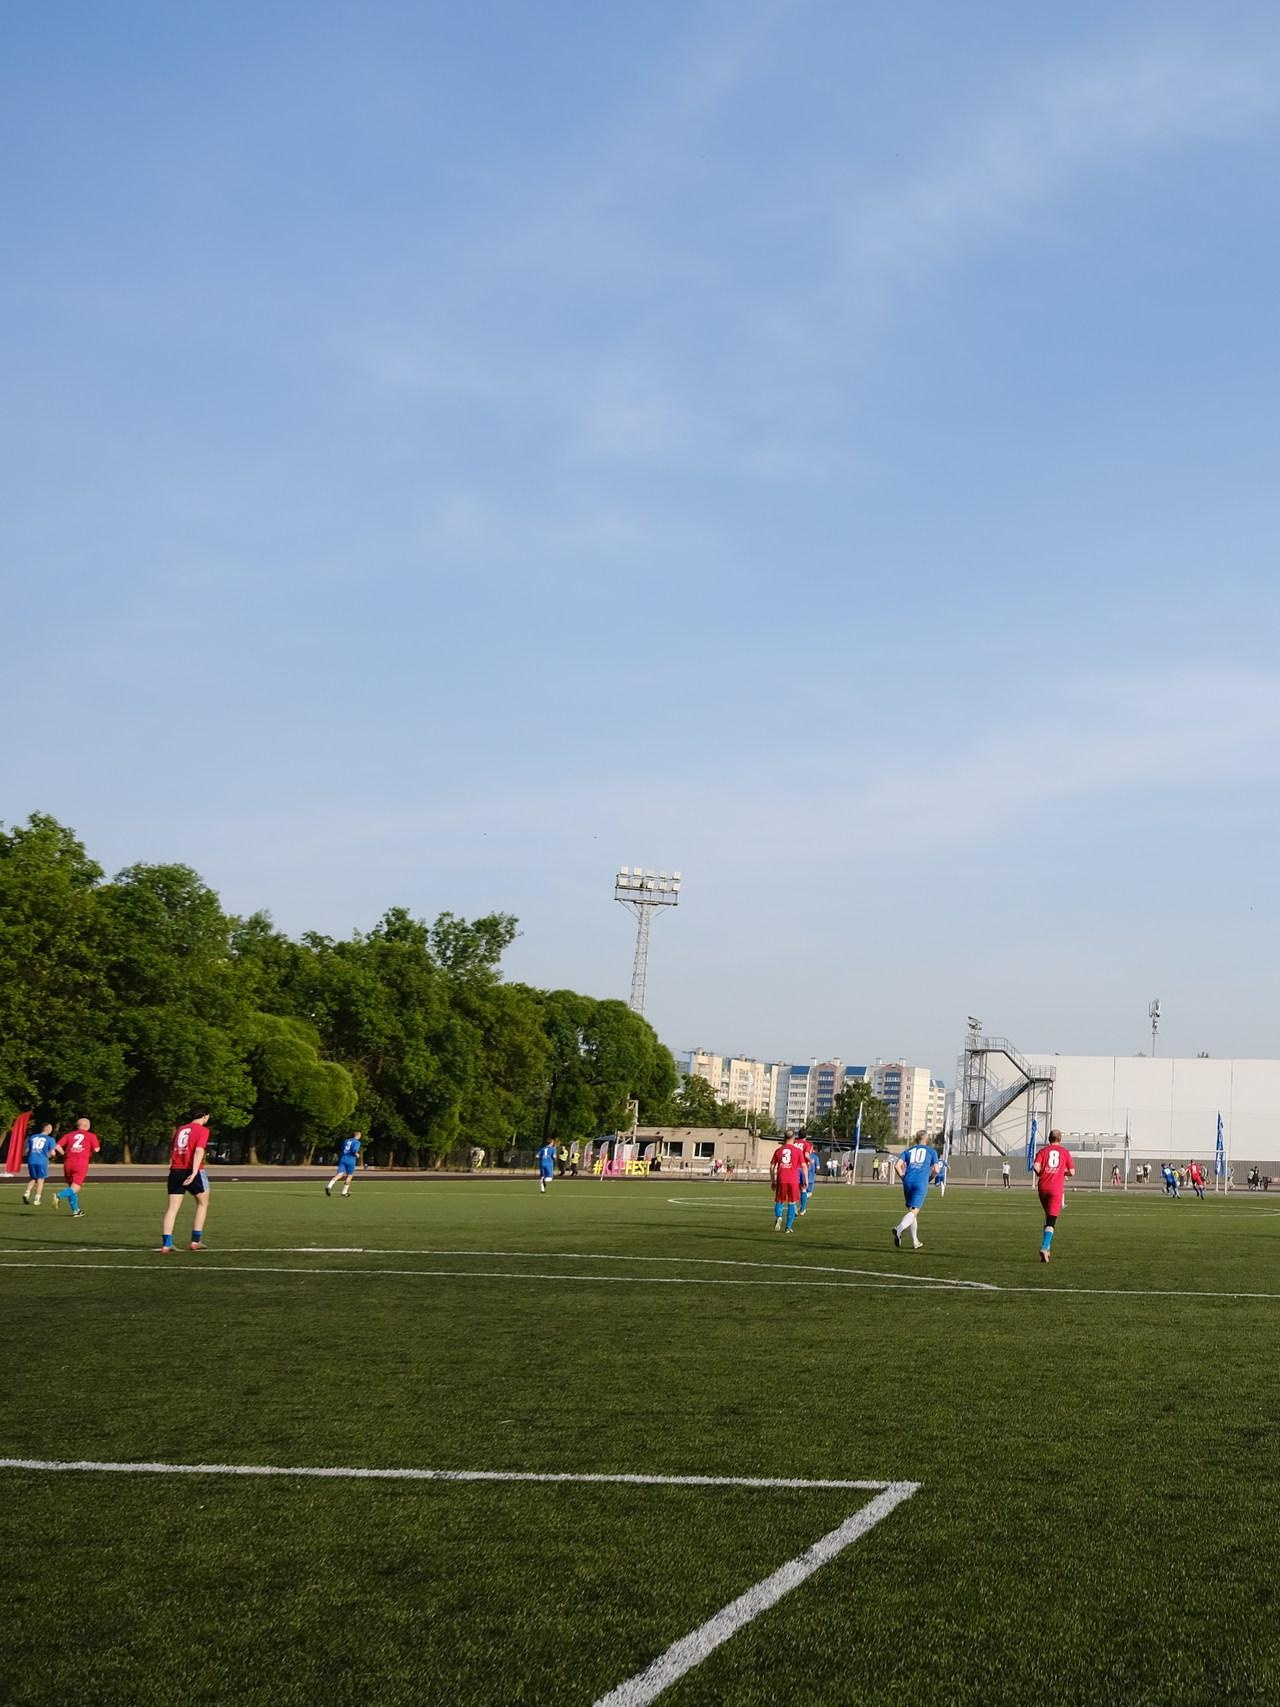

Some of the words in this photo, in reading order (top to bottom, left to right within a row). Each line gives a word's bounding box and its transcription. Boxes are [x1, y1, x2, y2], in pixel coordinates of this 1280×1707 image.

[31, 1136, 46, 1149] 16
[72, 1133, 85, 1148] 2
[177, 1128, 191, 1148] 6
[782, 1148, 791, 1164] 3
[909, 1147, 926, 1163] 10
[1048, 1150, 1060, 1168] 8
